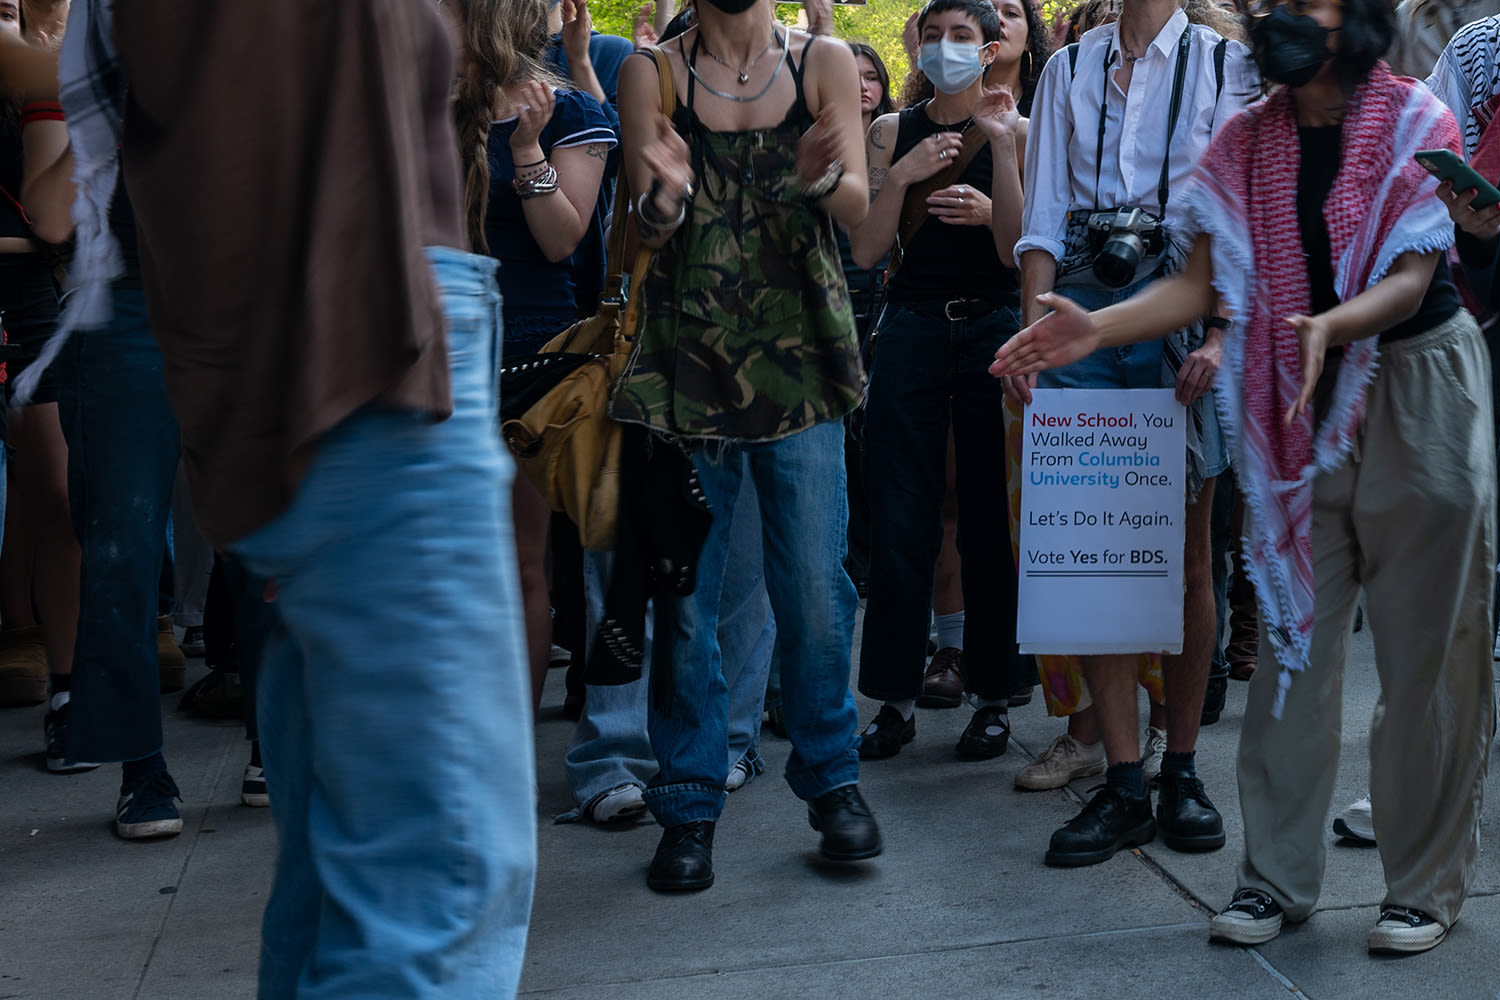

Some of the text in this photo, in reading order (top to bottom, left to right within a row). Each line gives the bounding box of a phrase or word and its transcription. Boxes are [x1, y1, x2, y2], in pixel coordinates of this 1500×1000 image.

[1031, 412, 1174, 430] New School, You
[1031, 432, 1148, 450] Walked Away
[1030, 451, 1160, 467] From Columbia
[1030, 470, 1172, 488] University Once.
[1029, 510, 1174, 529] Let's Do It Again.
[1027, 549, 1168, 565] Vote Yes for BDS.
